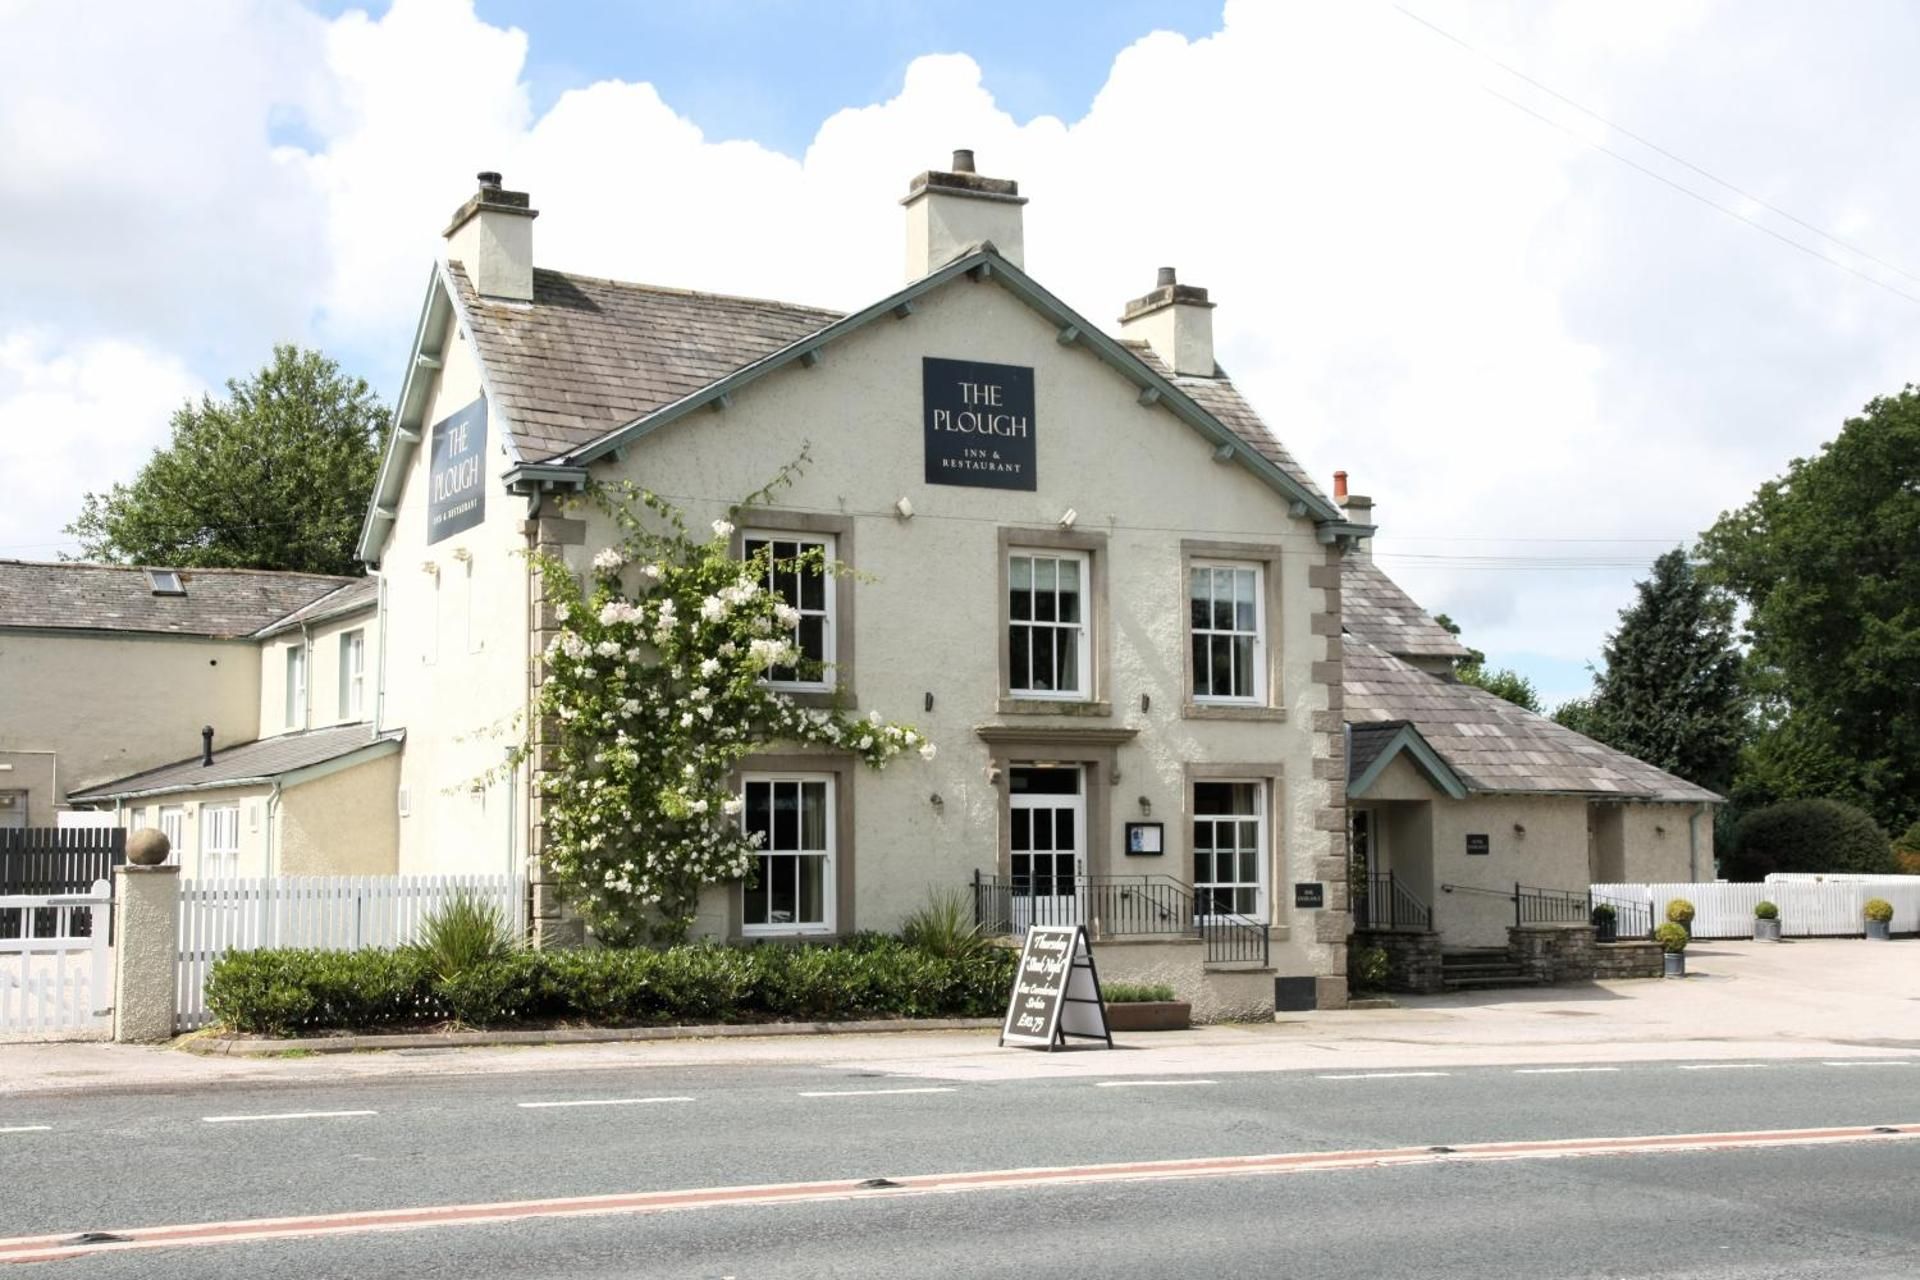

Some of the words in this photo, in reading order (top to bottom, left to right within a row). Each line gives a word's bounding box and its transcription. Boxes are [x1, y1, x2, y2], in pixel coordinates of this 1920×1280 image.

[957, 382, 1003, 406] THE
[933, 409, 1027, 438] PLOUGH
[448, 421, 469, 459] THE
[942, 458, 1021, 473] RESTAURANT
[964, 448, 986, 458] INN
[993, 451, 1001, 460] &
[433, 453, 479, 504] PLOUGH
[448, 497, 477, 519] RESTAURANT
[1034, 934, 1068, 957] Thursday
